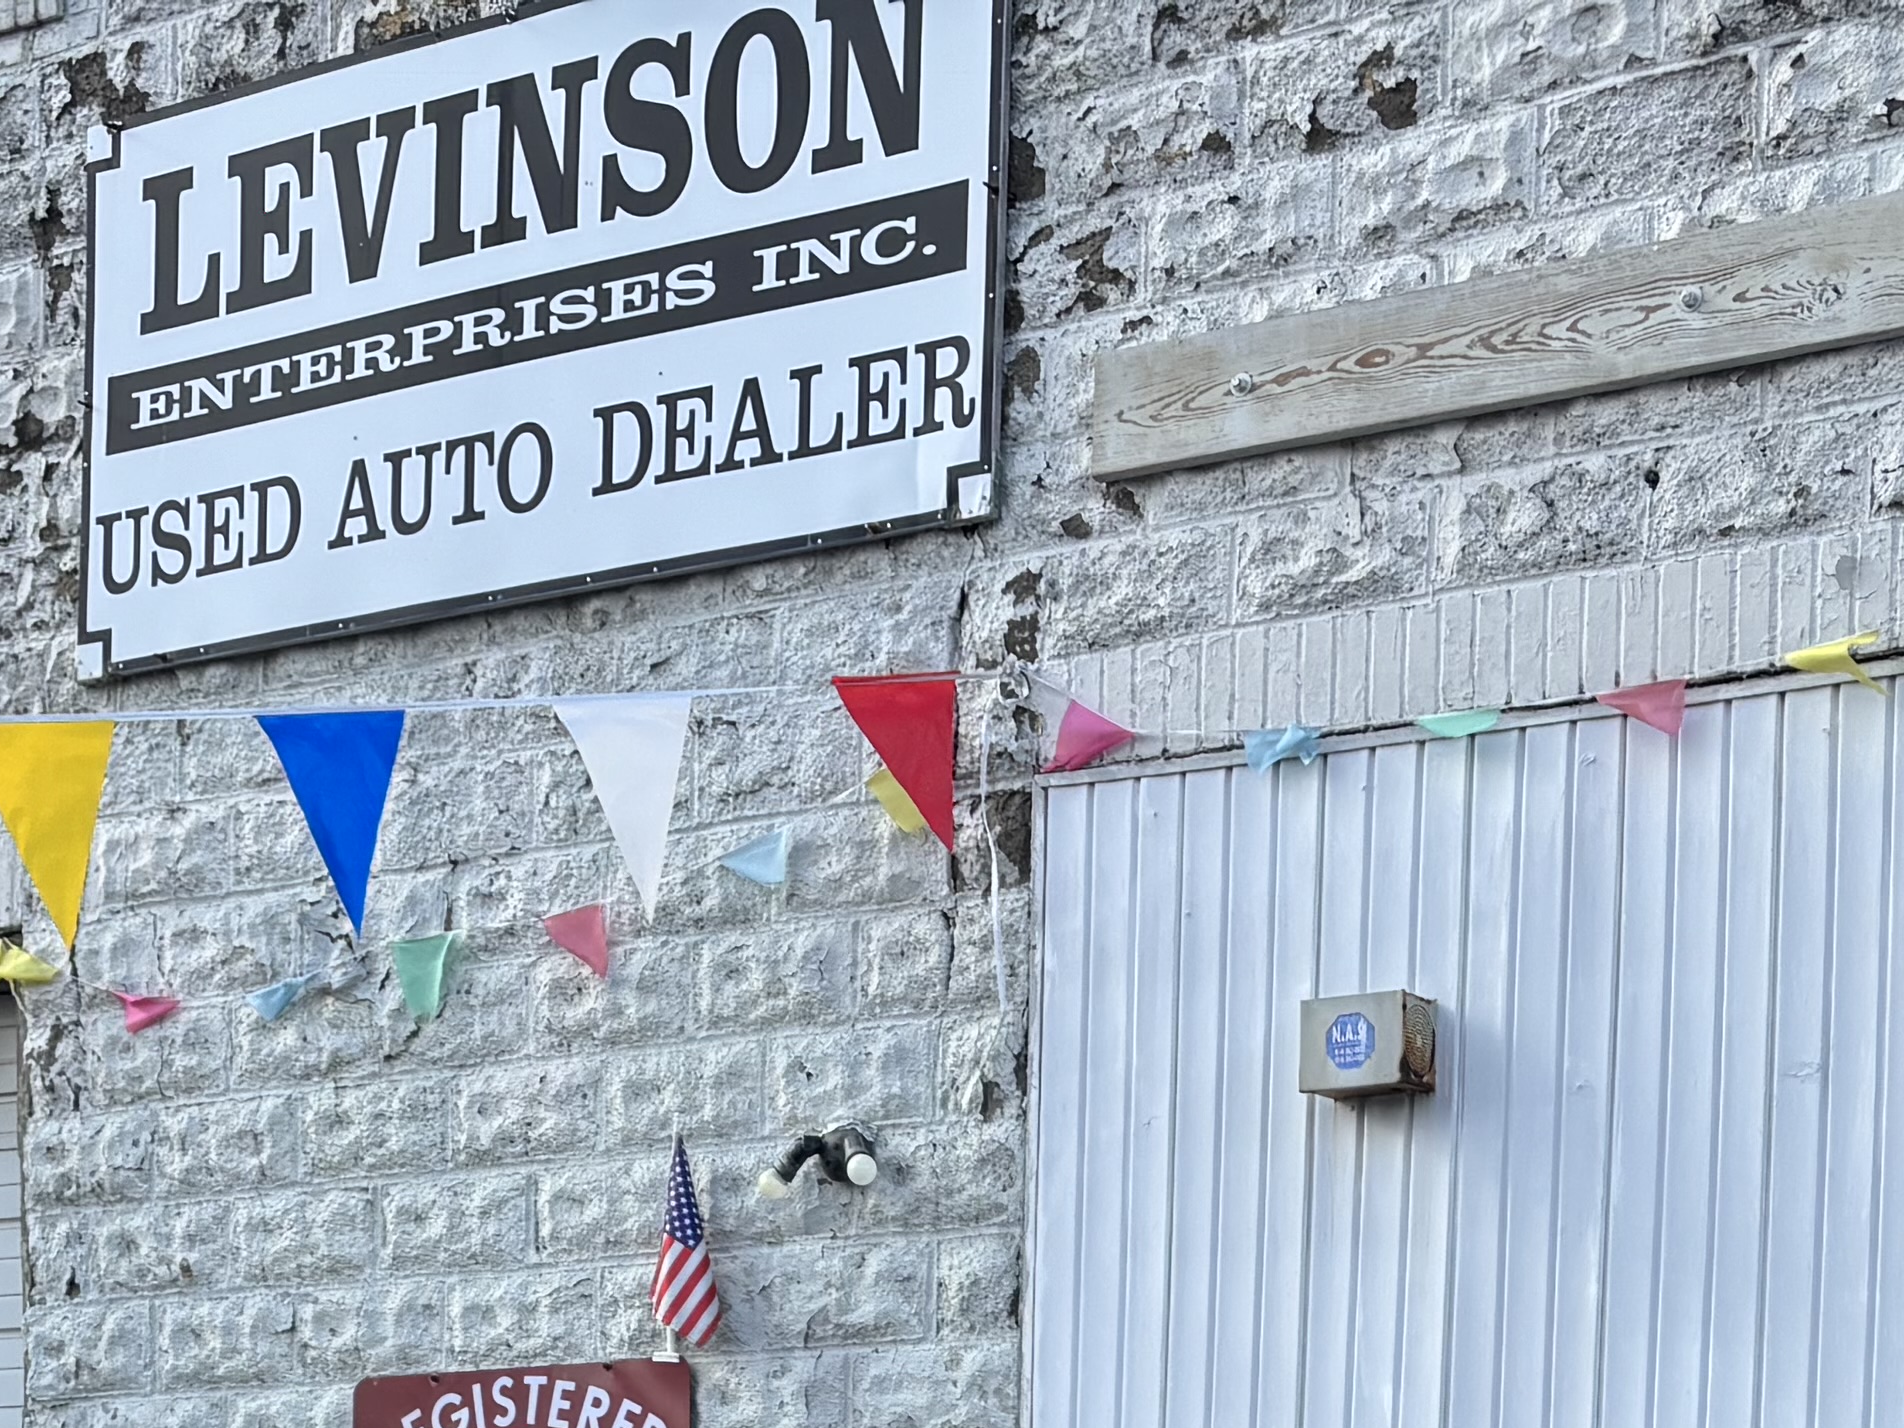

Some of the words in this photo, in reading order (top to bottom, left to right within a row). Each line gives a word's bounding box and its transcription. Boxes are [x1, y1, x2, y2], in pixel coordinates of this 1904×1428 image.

[140, 0, 925, 335] LEVINSON
[129, 260, 716, 431] ENTERPRISES
[750, 216, 939, 292] INC.
[96, 474, 302, 595] USED
[327, 422, 553, 550] AUTO
[591, 335, 976, 498] DEALER
